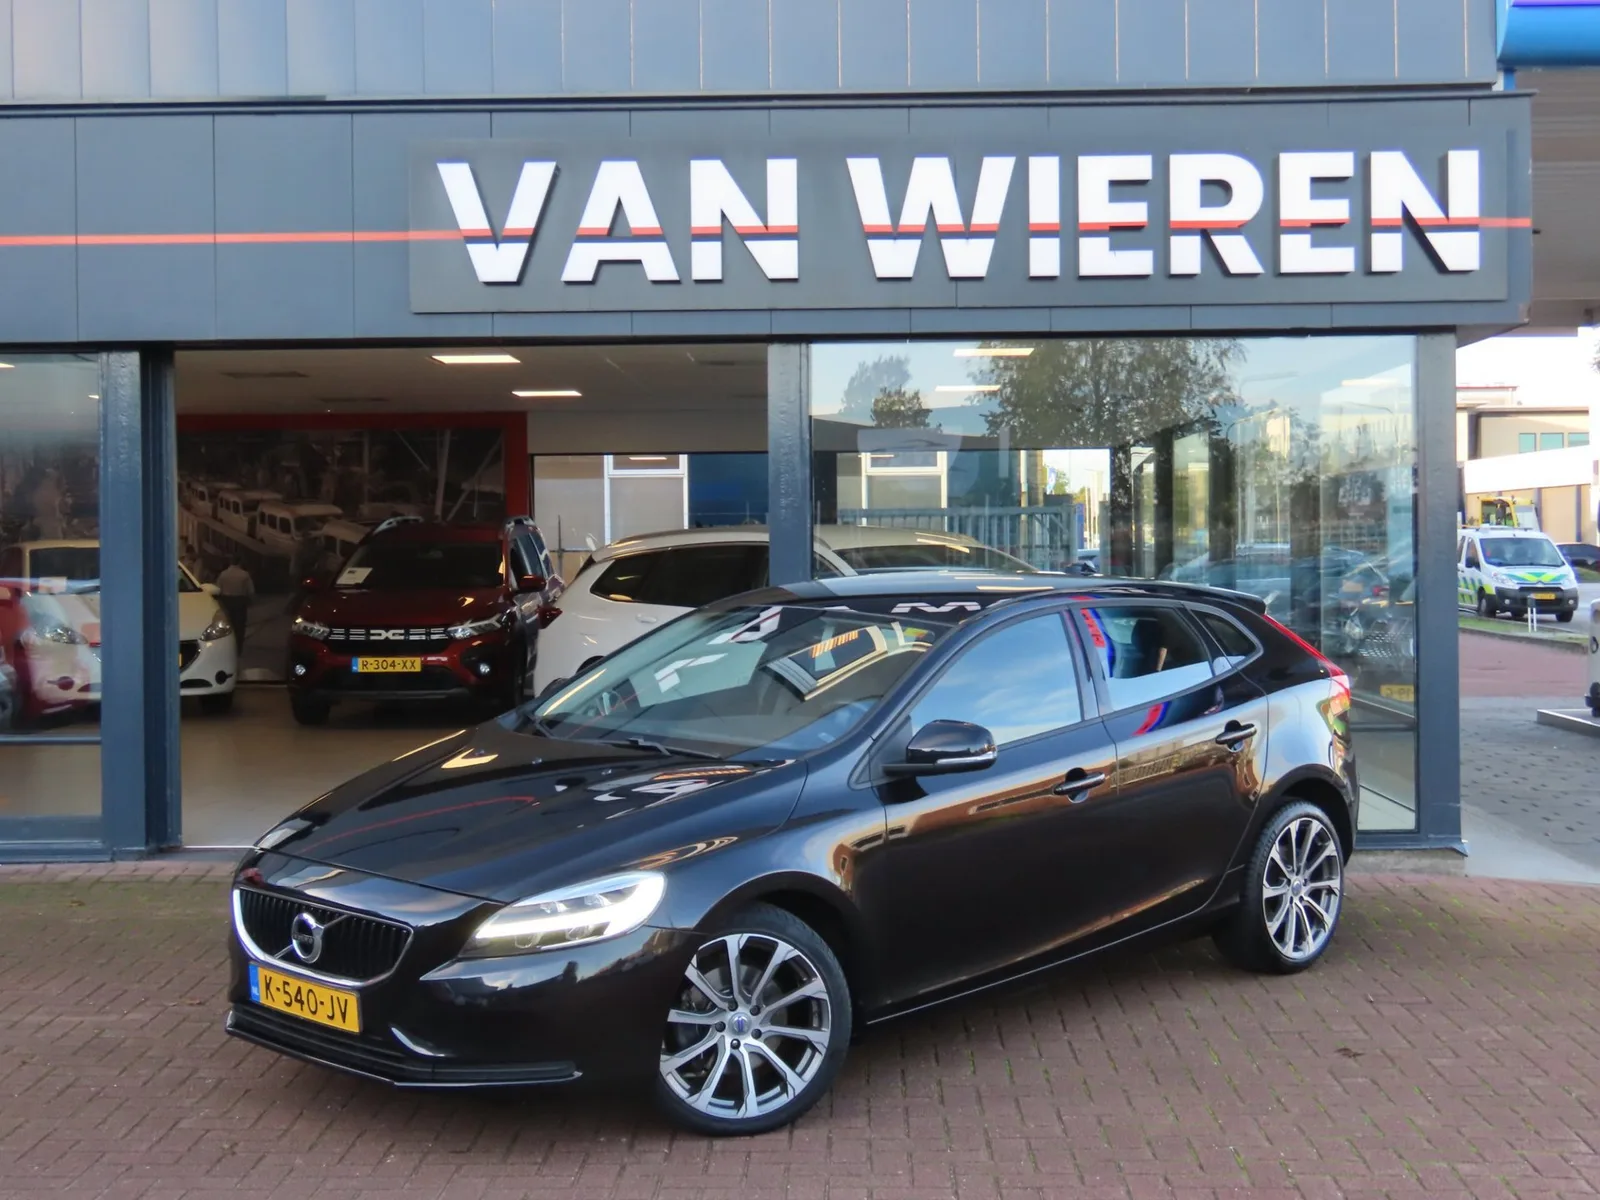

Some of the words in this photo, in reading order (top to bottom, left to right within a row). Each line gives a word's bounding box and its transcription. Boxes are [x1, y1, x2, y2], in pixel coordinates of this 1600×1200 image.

[436, 158, 799, 283] VAN
[845, 149, 1480, 280] WIEREN
[361, 659, 416, 670] R-304-XX
[264, 974, 348, 1024] K-540-JV
